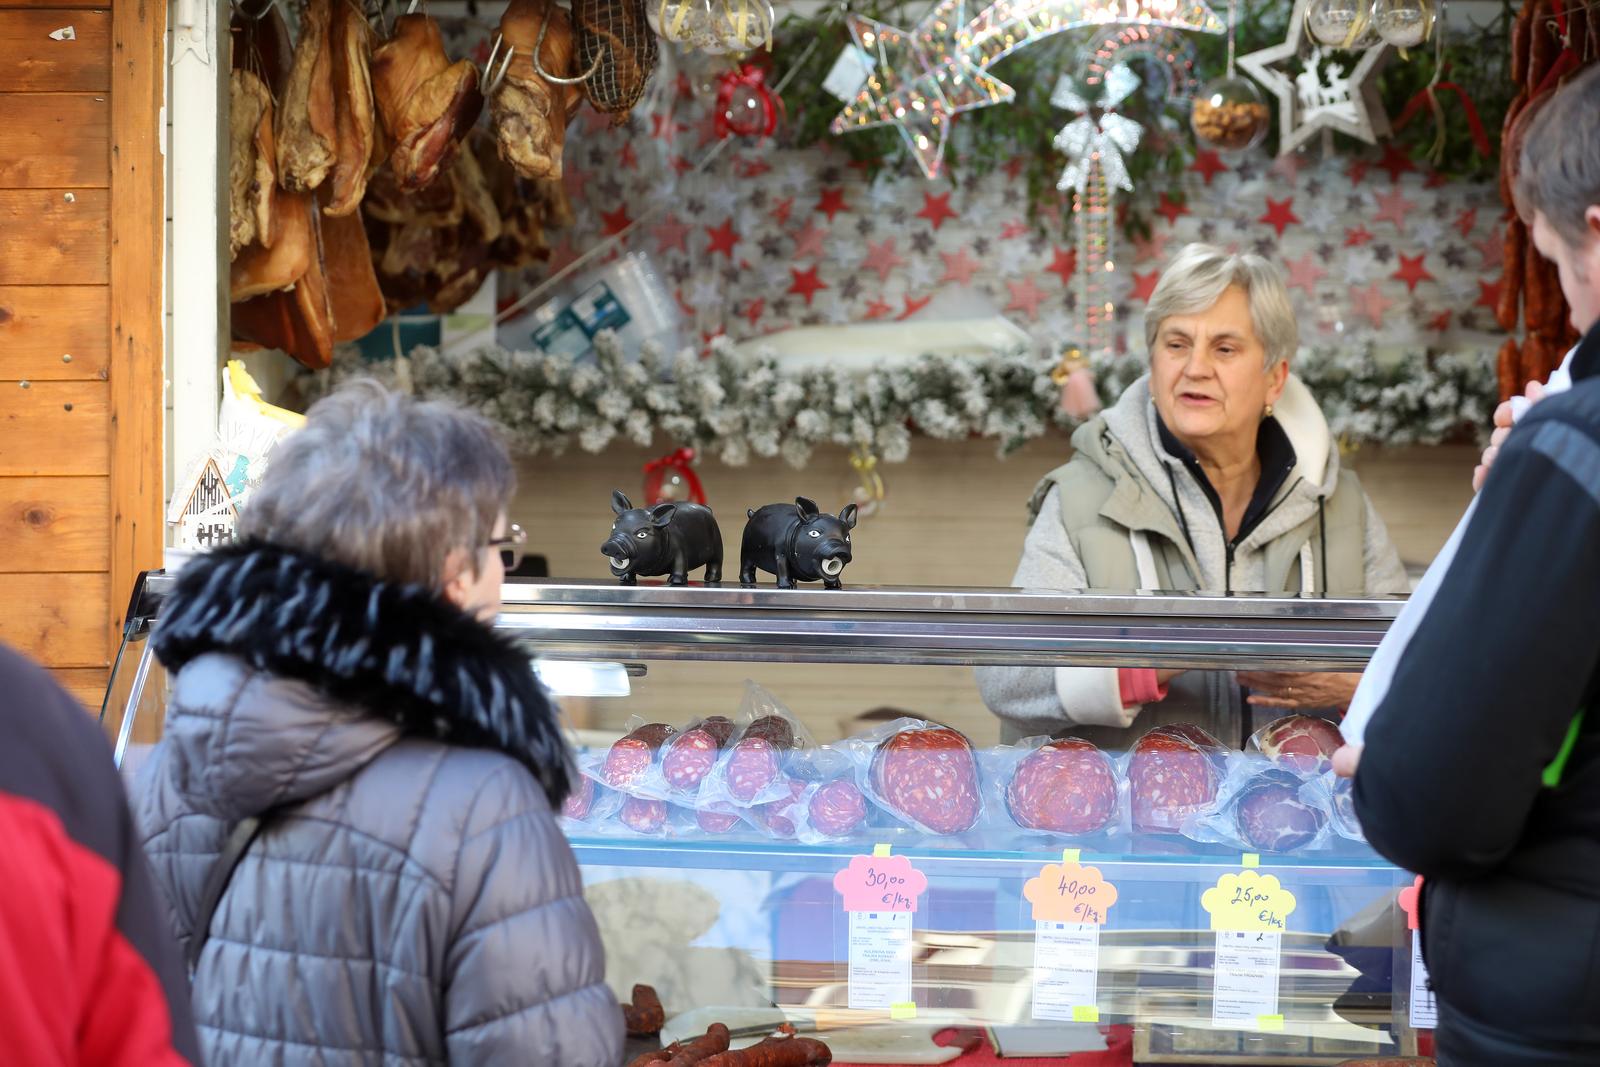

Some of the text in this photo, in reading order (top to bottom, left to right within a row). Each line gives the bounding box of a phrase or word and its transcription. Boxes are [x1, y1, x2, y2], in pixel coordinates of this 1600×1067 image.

[865, 867, 905, 890] 30,00
[1057, 875, 1096, 900] 40,00
[1231, 887, 1269, 907] 25,00
